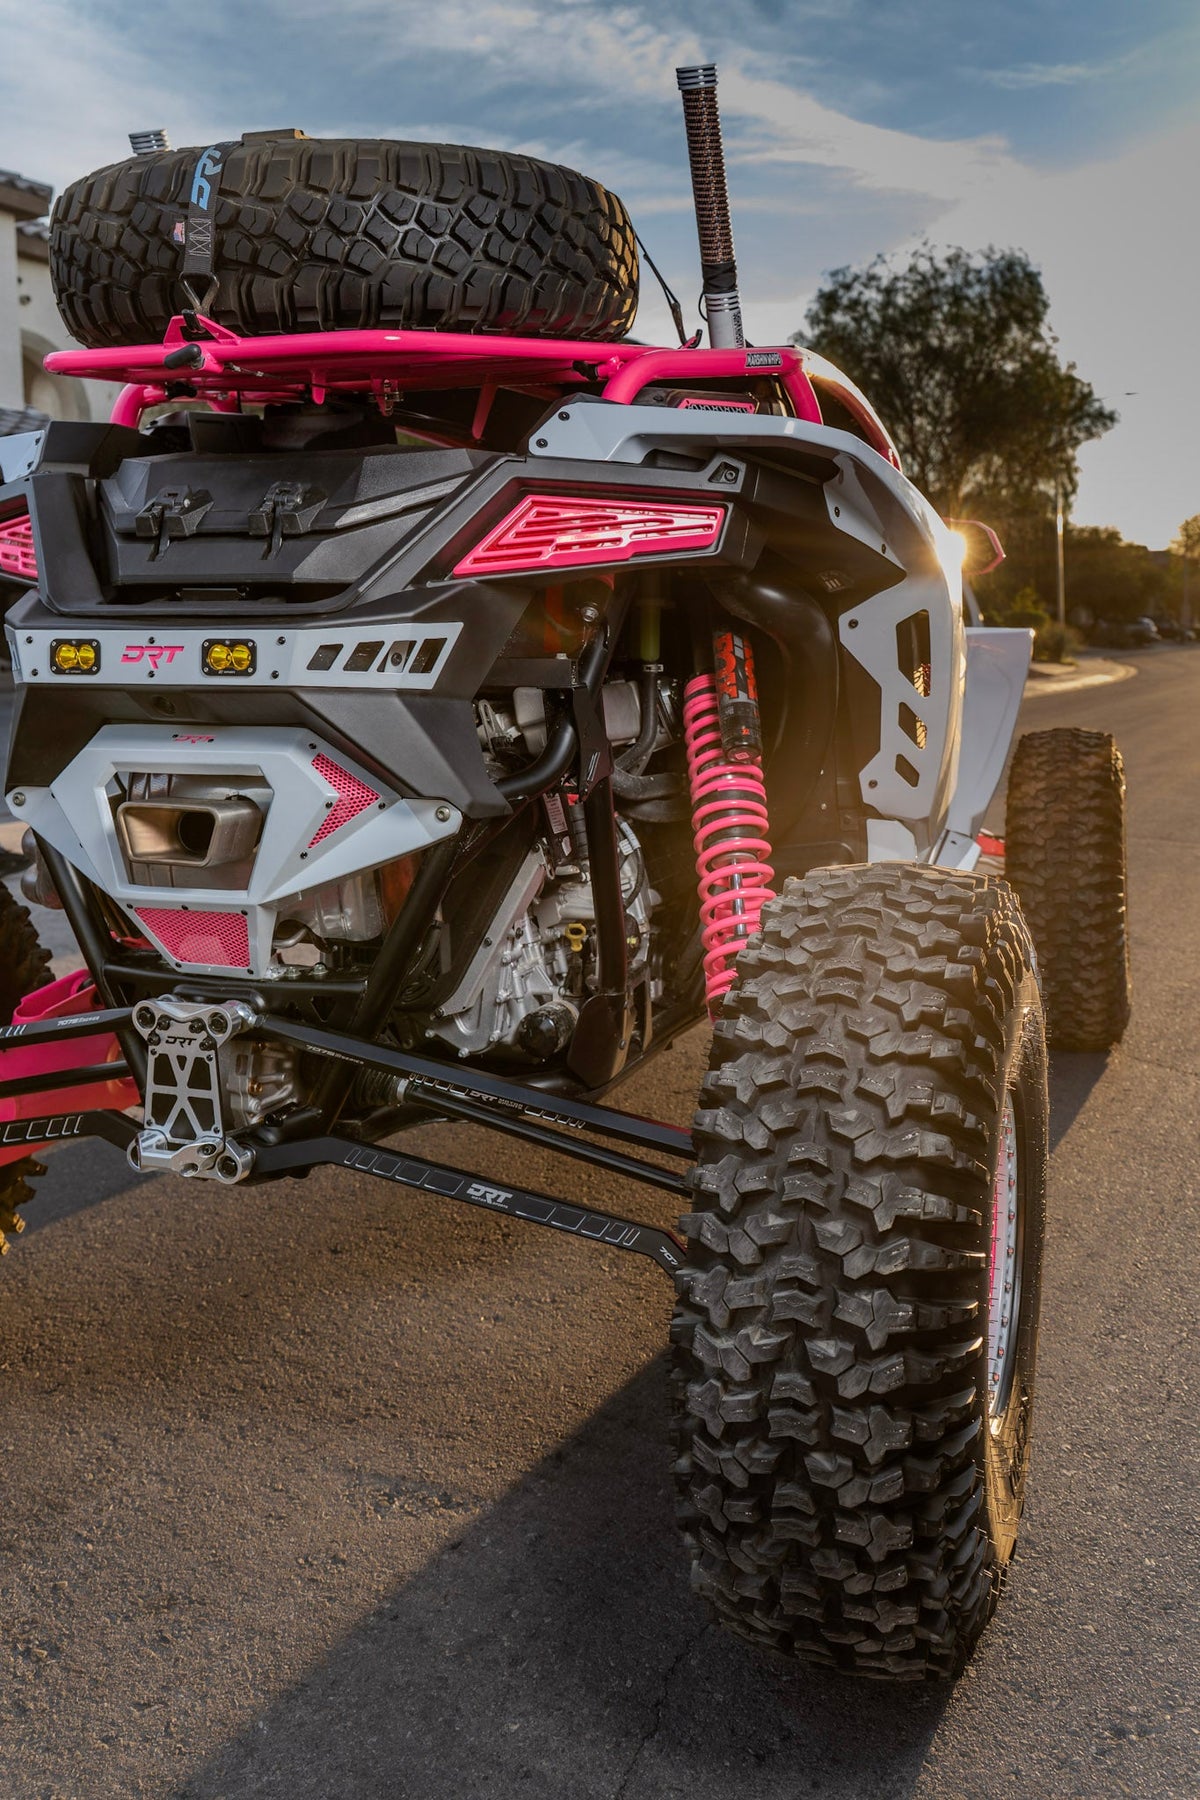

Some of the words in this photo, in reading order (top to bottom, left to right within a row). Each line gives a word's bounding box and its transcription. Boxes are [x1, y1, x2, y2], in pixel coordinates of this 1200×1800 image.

[121, 646, 184, 669] DRT
[175, 734, 216, 744] DRT
[165, 1036, 197, 1048] DRT
[470, 1090, 498, 1101] DRT
[466, 1183, 513, 1204] DRT
